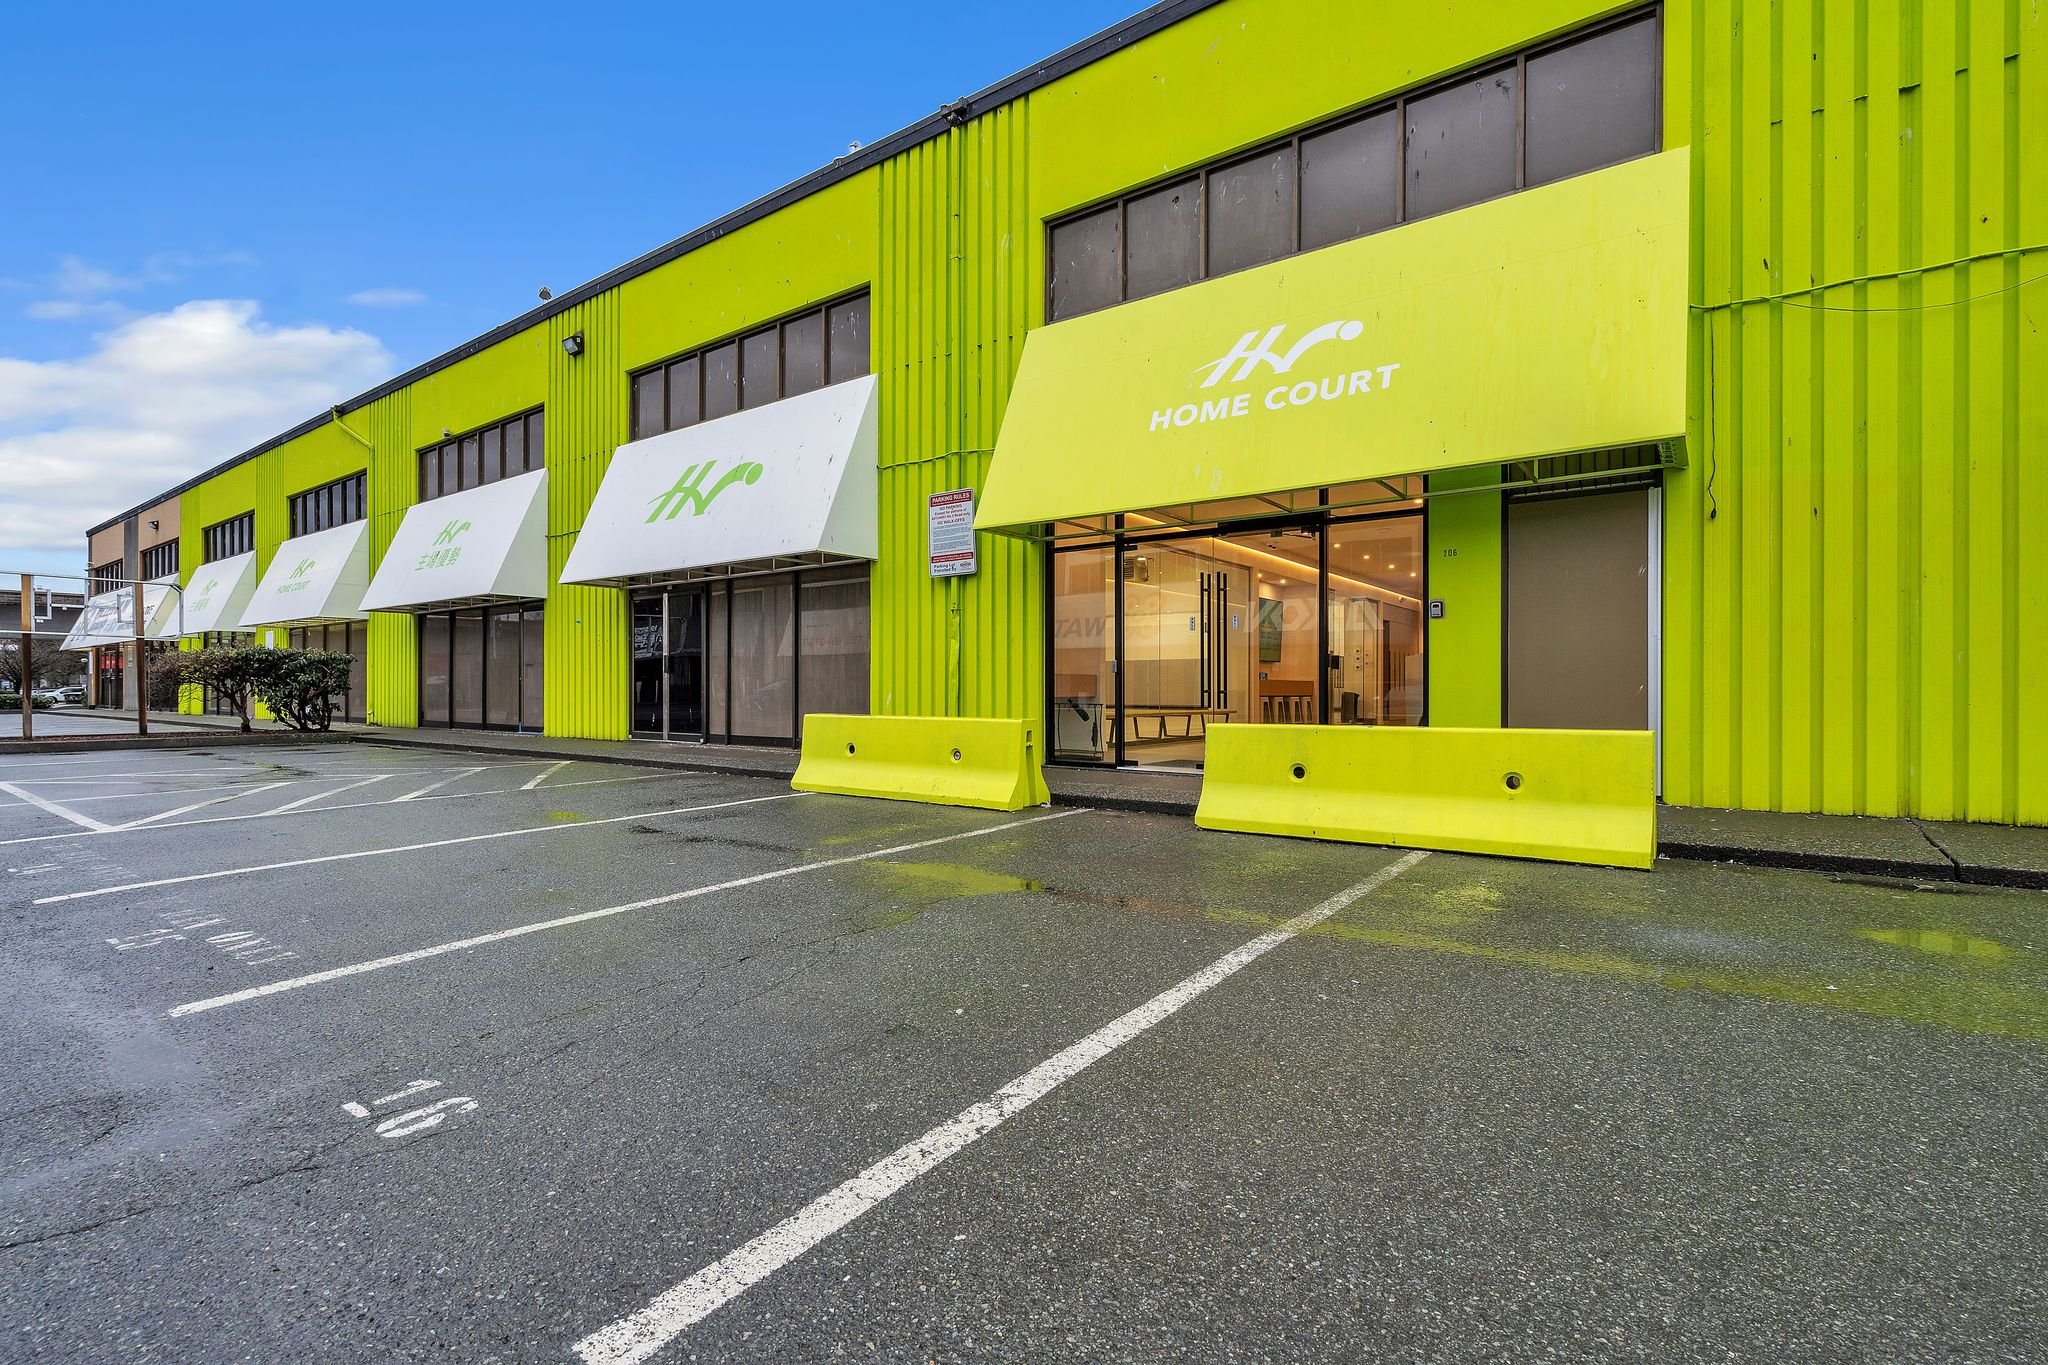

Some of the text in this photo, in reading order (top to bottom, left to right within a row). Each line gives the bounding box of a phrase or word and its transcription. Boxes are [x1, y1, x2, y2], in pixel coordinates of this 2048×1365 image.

[1149, 363, 1401, 432] HOME COURT
[932, 492, 970, 503] PARKING RULES
[1443, 548, 1457, 558] 206
[341, 1079, 479, 1138] 16
